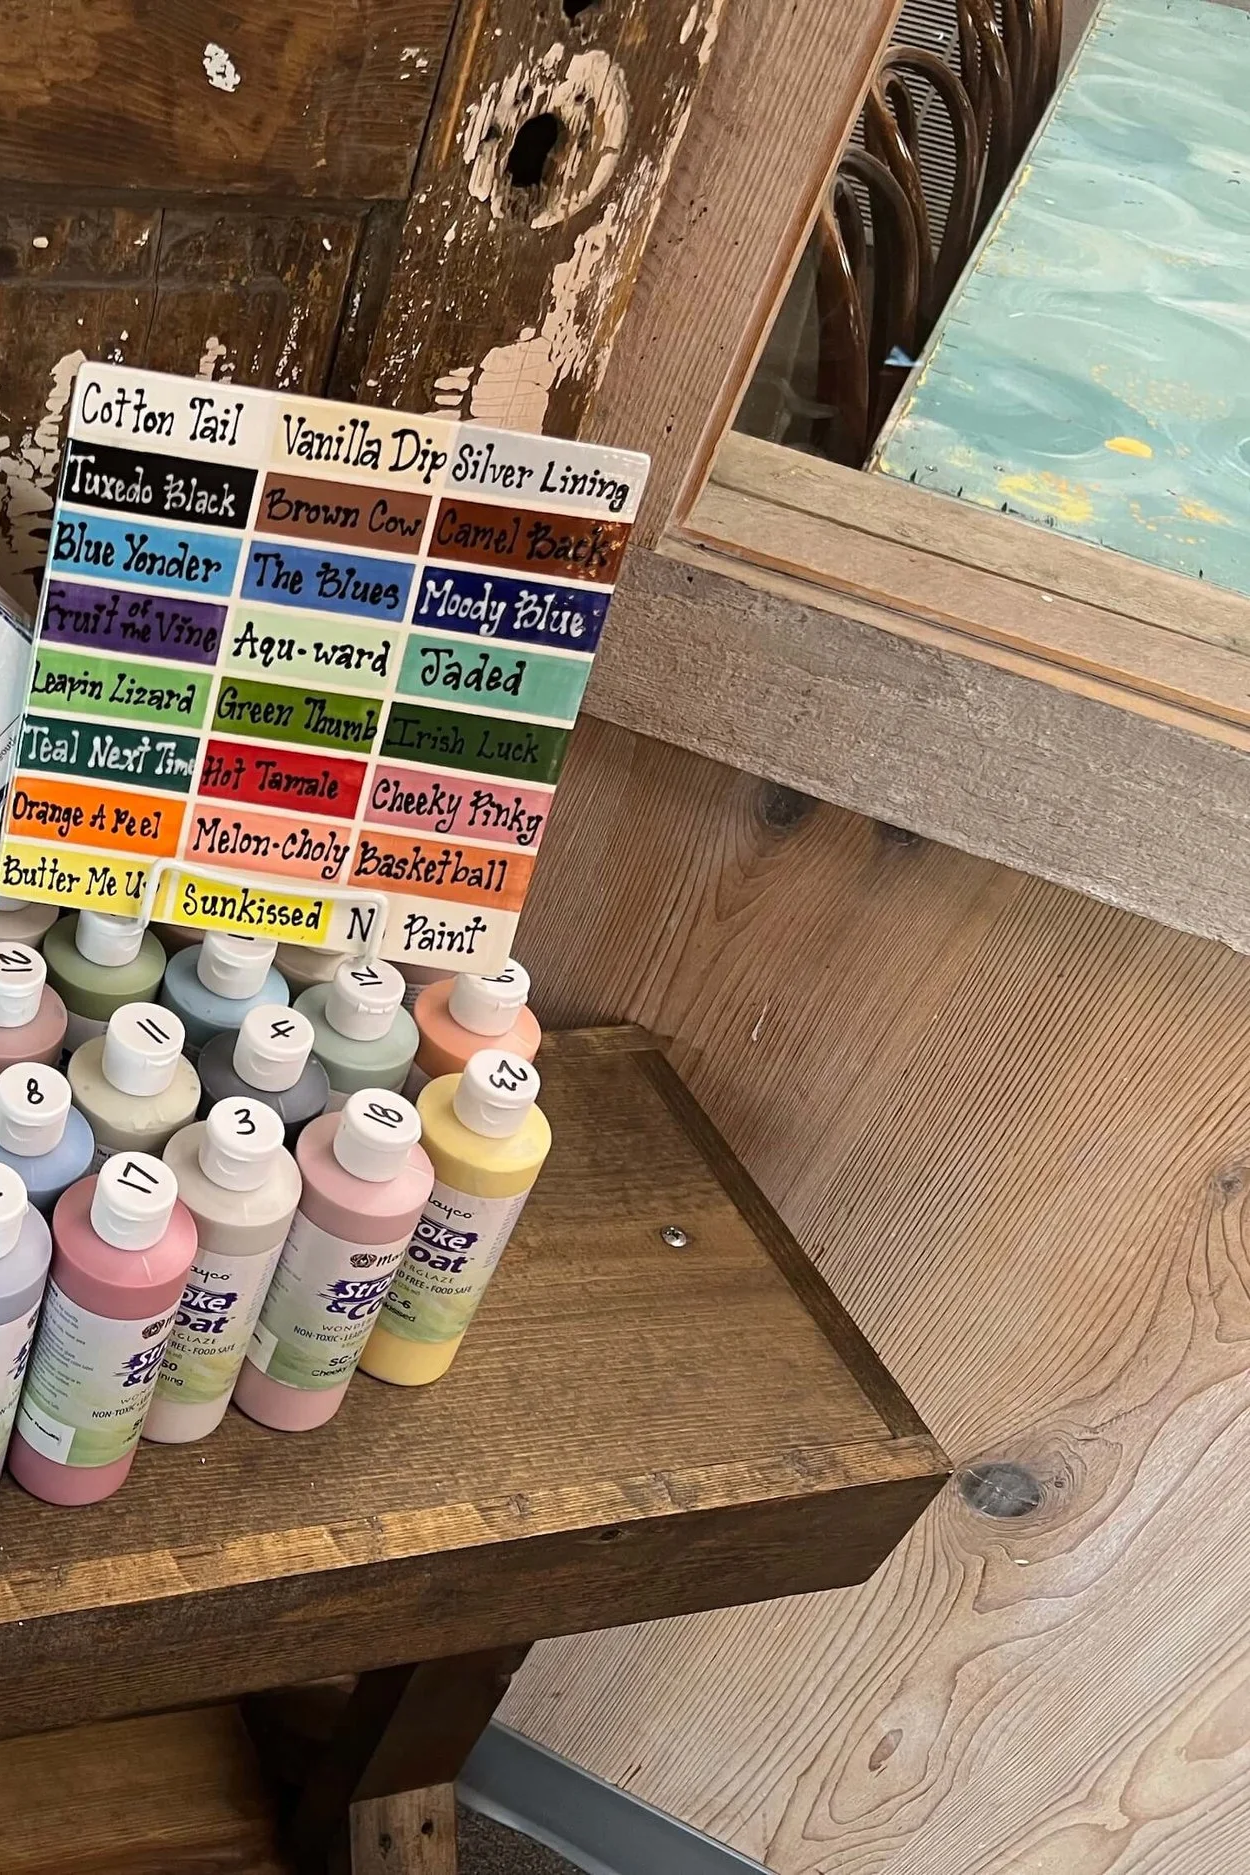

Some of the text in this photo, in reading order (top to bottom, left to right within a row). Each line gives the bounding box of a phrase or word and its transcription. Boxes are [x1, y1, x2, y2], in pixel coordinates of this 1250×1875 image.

[81, 382, 244, 446] Cotton Tail
[283, 414, 448, 484] Vanilla Dip
[70, 454, 236, 518] Tuxedo Black
[451, 443, 630, 513] Silver Lining
[266, 487, 423, 537] Brown Cow
[52, 521, 223, 583] Blue Yonder
[436, 508, 611, 568] Camel Back
[253, 552, 400, 610] The Blues
[43, 590, 120, 635] Fruit
[128, 599, 153, 618] of
[155, 611, 218, 653] Vine
[419, 578, 587, 638] Moody Blue
[232, 620, 391, 677] Aqu-ward
[420, 647, 527, 696] Jaded
[31, 660, 196, 713] Leapin Lizard
[217, 686, 378, 742] Green Thumb
[25, 724, 80, 764] Teal
[87, 735, 152, 774] Next
[385, 717, 539, 764] Irish Luck
[202, 755, 339, 799] Hot Tamale
[12, 791, 162, 839] Orange A Peel
[372, 778, 544, 846] Cheeky Pinky
[2, 855, 81, 893] Butter
[84, 866, 117, 897] Me
[354, 840, 507, 892] Basketball
[182, 883, 323, 930] Sunkissed
[403, 913, 487, 954] Paint
[269, 1019, 296, 1040] 4
[26, 1077, 45, 1105] 8
[233, 1107, 257, 1136] 3
[363, 1102, 404, 1129] 18
[116, 1161, 160, 1194] 17
[428, 1192, 473, 1219] ayco
[408, 1245, 468, 1273] oat
[417, 1223, 468, 1250] oke
[339, 1273, 395, 1299] Stro
[348, 1296, 383, 1321] Co
[387, 1291, 412, 1309] C-6
[430, 1285, 454, 1295] FOOD
[174, 1311, 230, 1333] oat
[328, 1350, 359, 1367] SC-1
